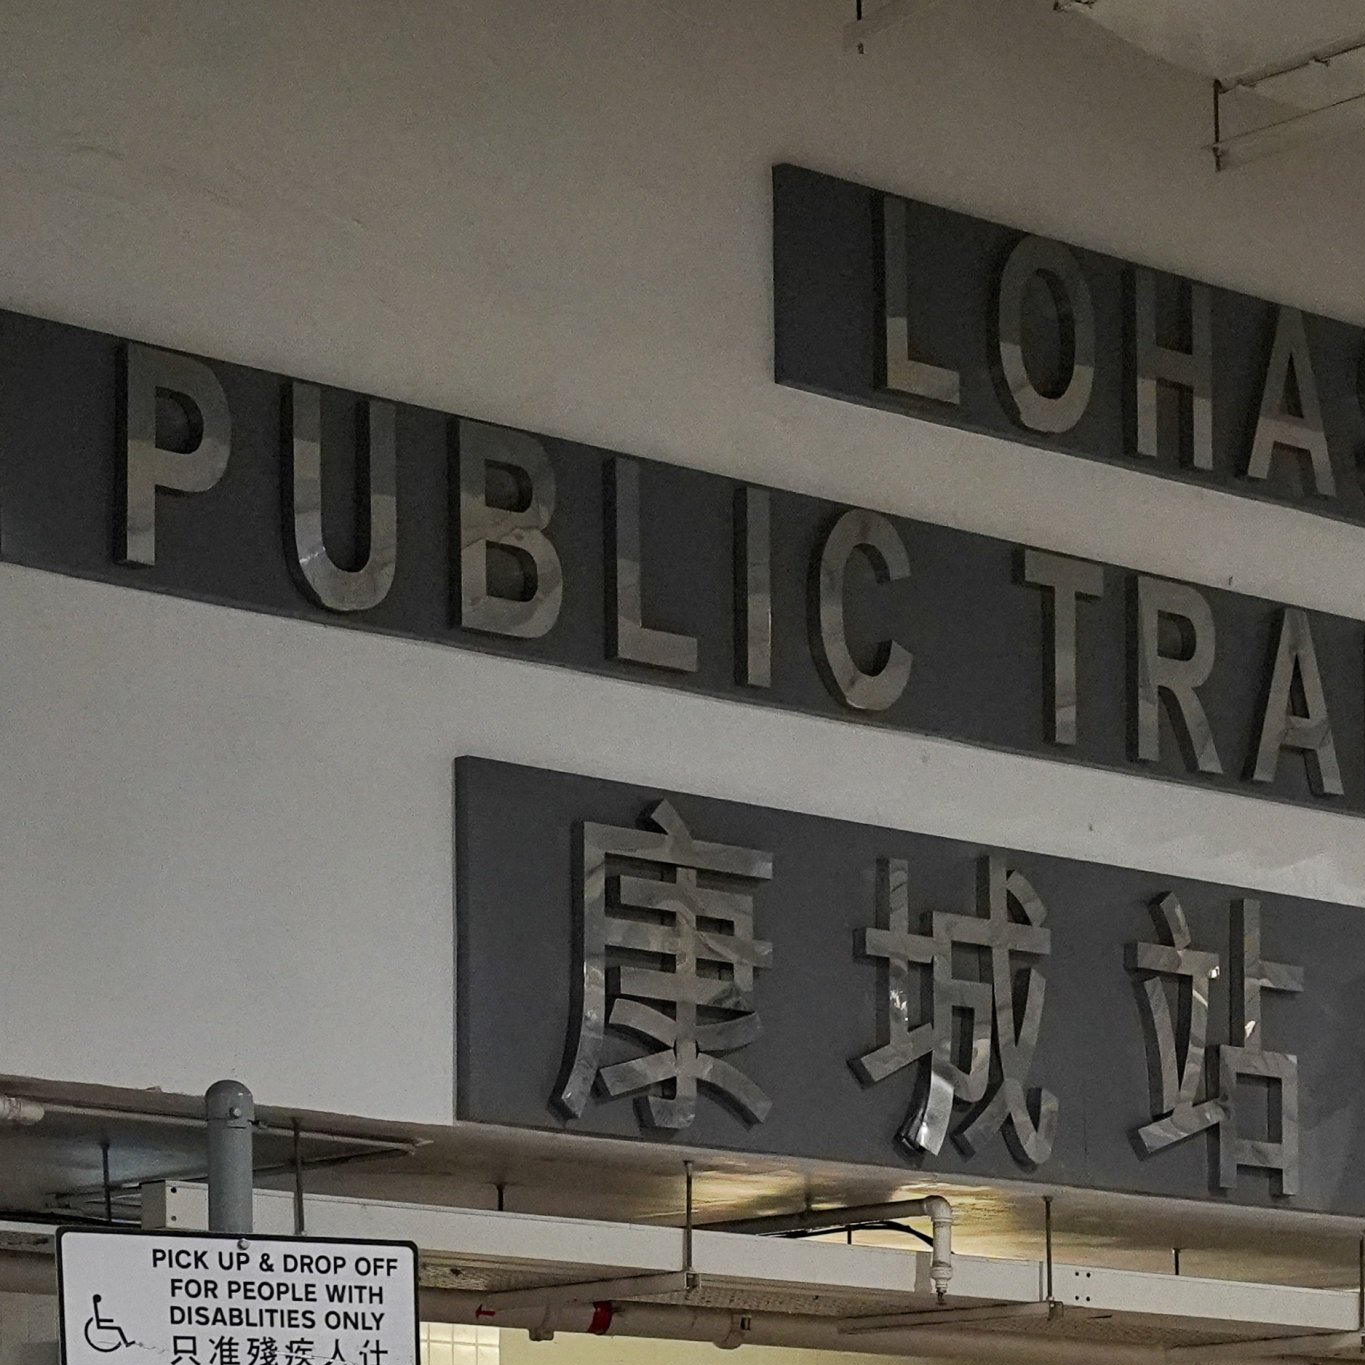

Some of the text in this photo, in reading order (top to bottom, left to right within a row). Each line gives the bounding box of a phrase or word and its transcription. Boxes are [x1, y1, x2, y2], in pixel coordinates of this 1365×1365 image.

[118, 340, 914, 711] PUBLIC
[152, 1248, 399, 1276] PICK UP & DROP OFF
[170, 1278, 384, 1304] FOR PEOPLE WITH
[170, 1305, 385, 1331] DISABLITIES ONLY
